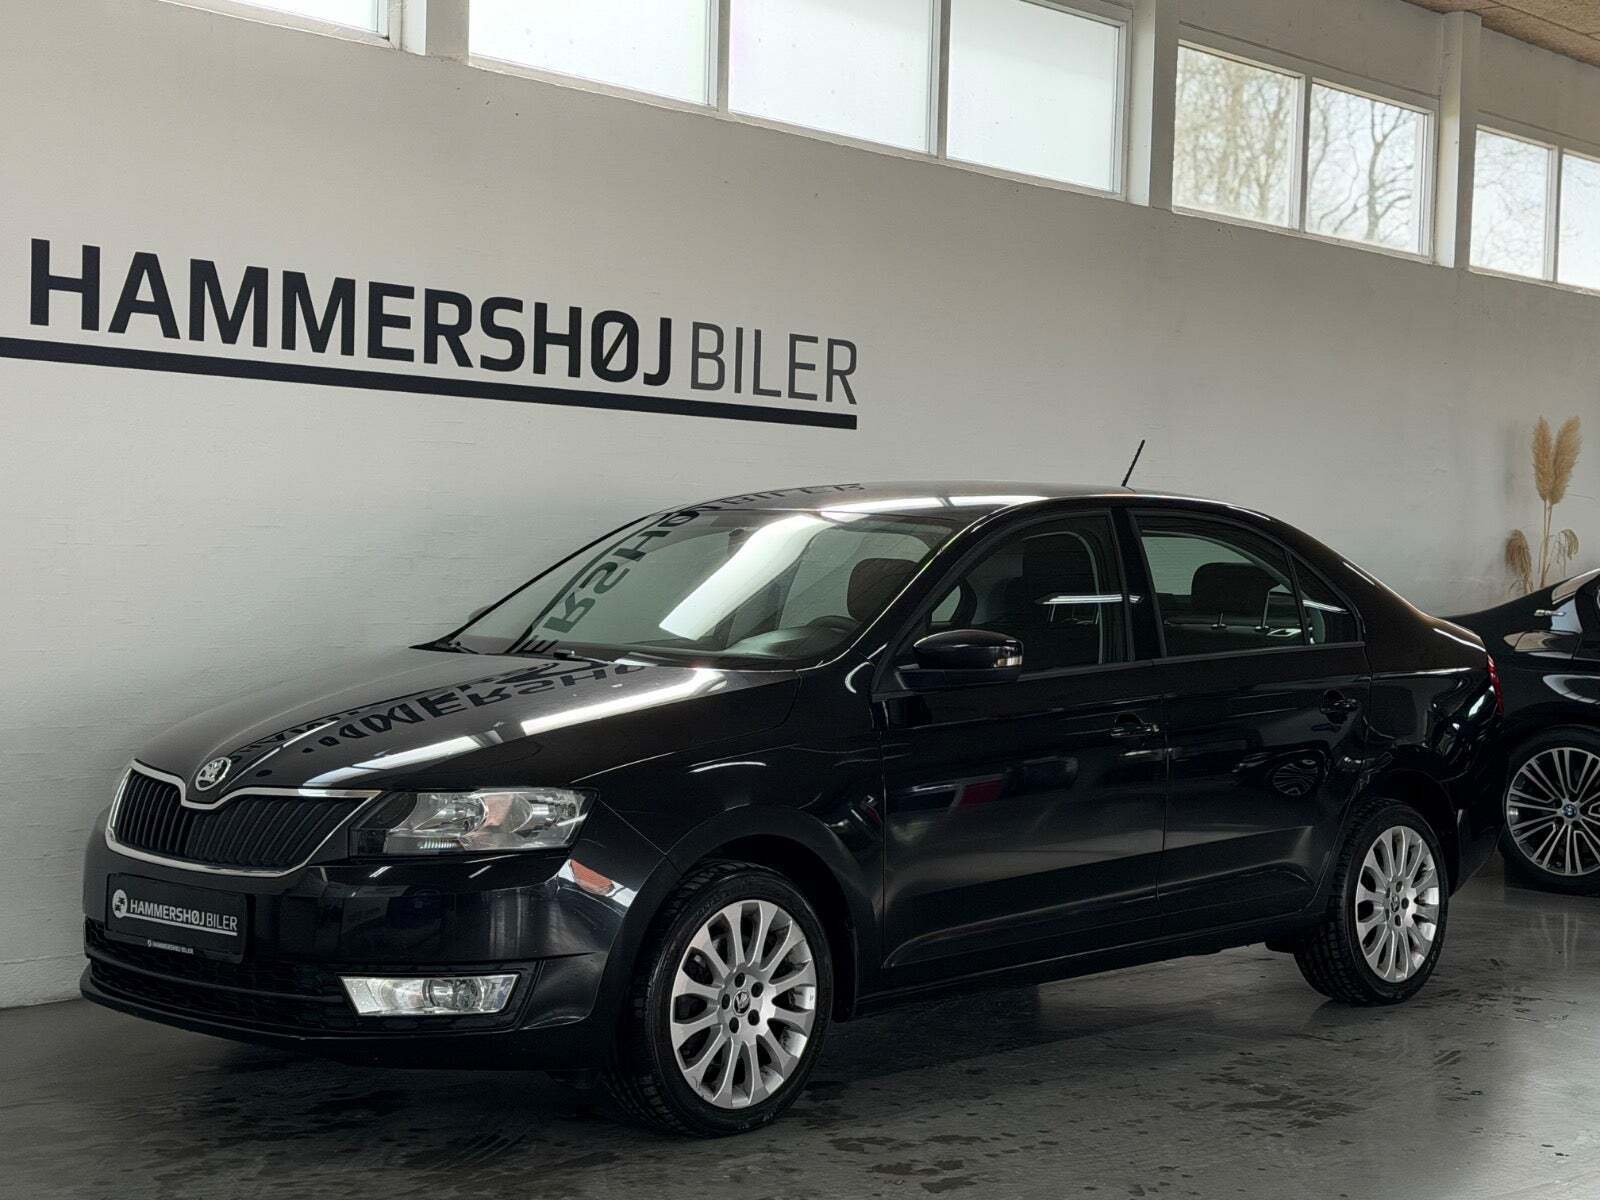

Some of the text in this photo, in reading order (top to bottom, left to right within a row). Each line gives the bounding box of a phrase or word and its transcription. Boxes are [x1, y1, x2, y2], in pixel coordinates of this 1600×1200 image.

[29, 237, 858, 405] HAMMERSHØJ BILER
[130, 898, 238, 932] HAMMERSHØJ BILER
